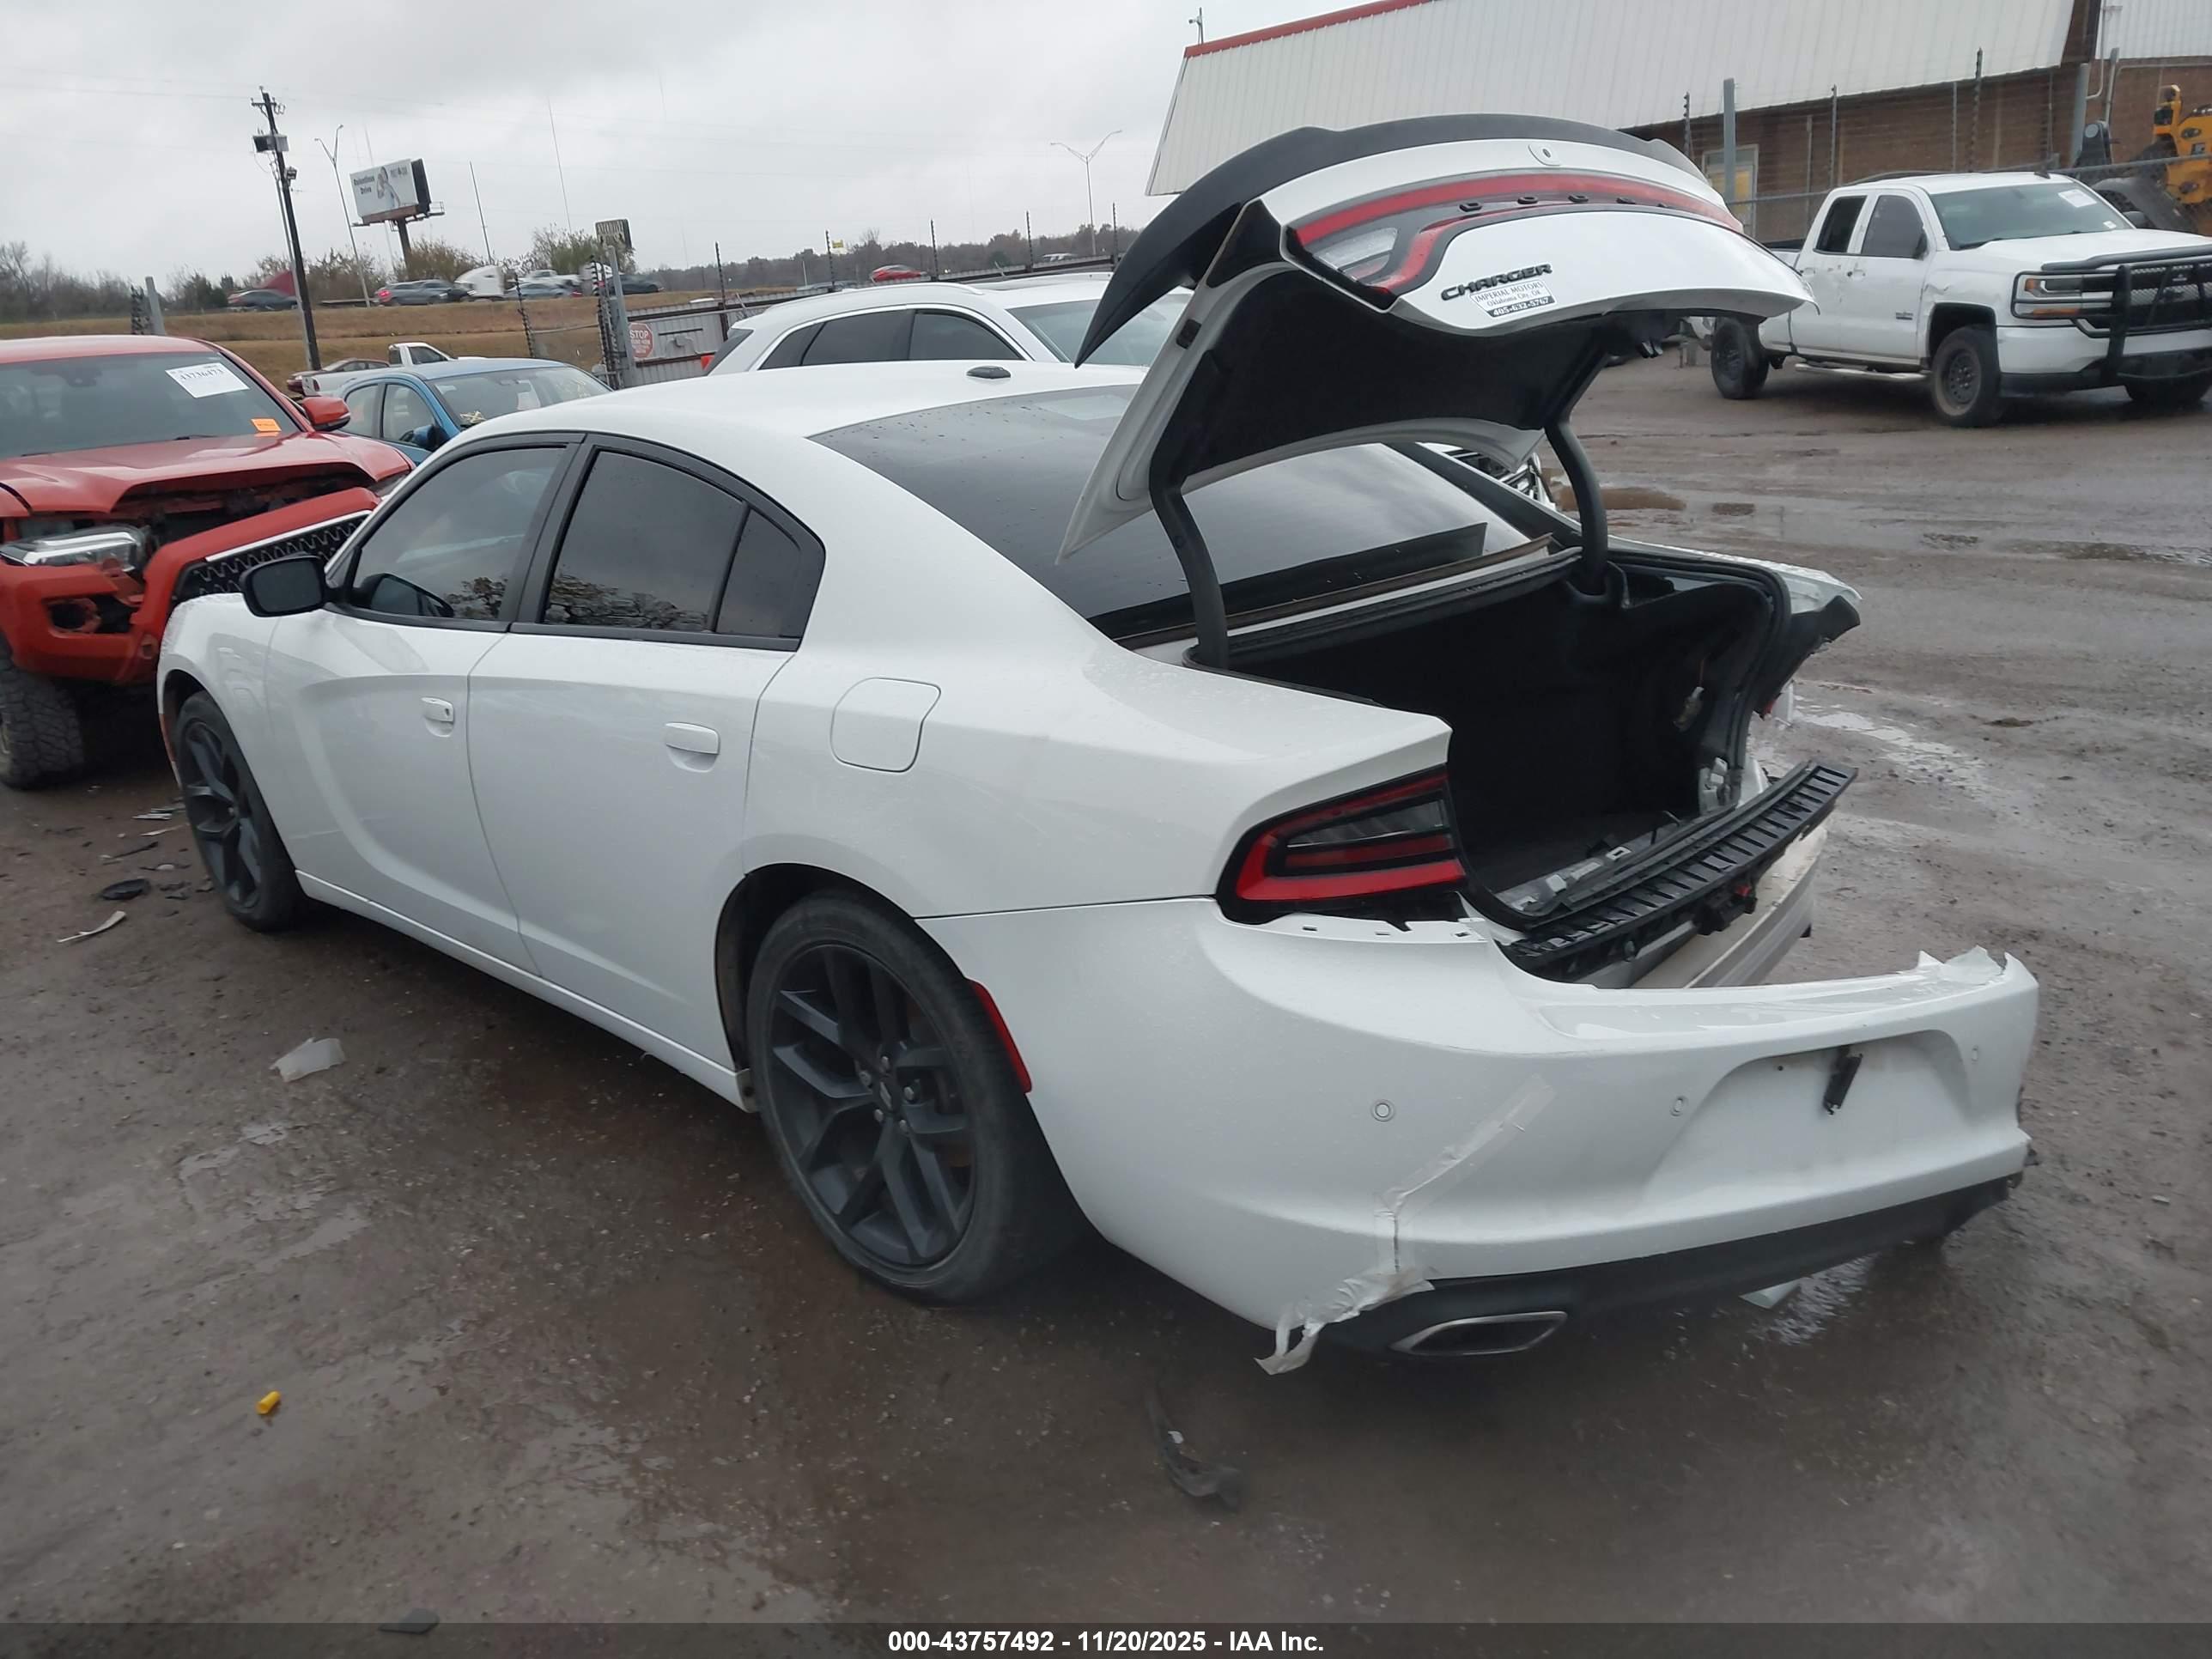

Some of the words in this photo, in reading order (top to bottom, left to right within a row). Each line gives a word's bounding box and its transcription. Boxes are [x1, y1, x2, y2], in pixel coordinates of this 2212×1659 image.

[1441, 264, 1553, 301] CHARGER
[1474, 289, 1510, 302] IMPERIAL
[1511, 281, 1544, 295] MOTORS
[1487, 295, 1517, 307] Oklahoma
[629, 329, 649, 339] STOP
